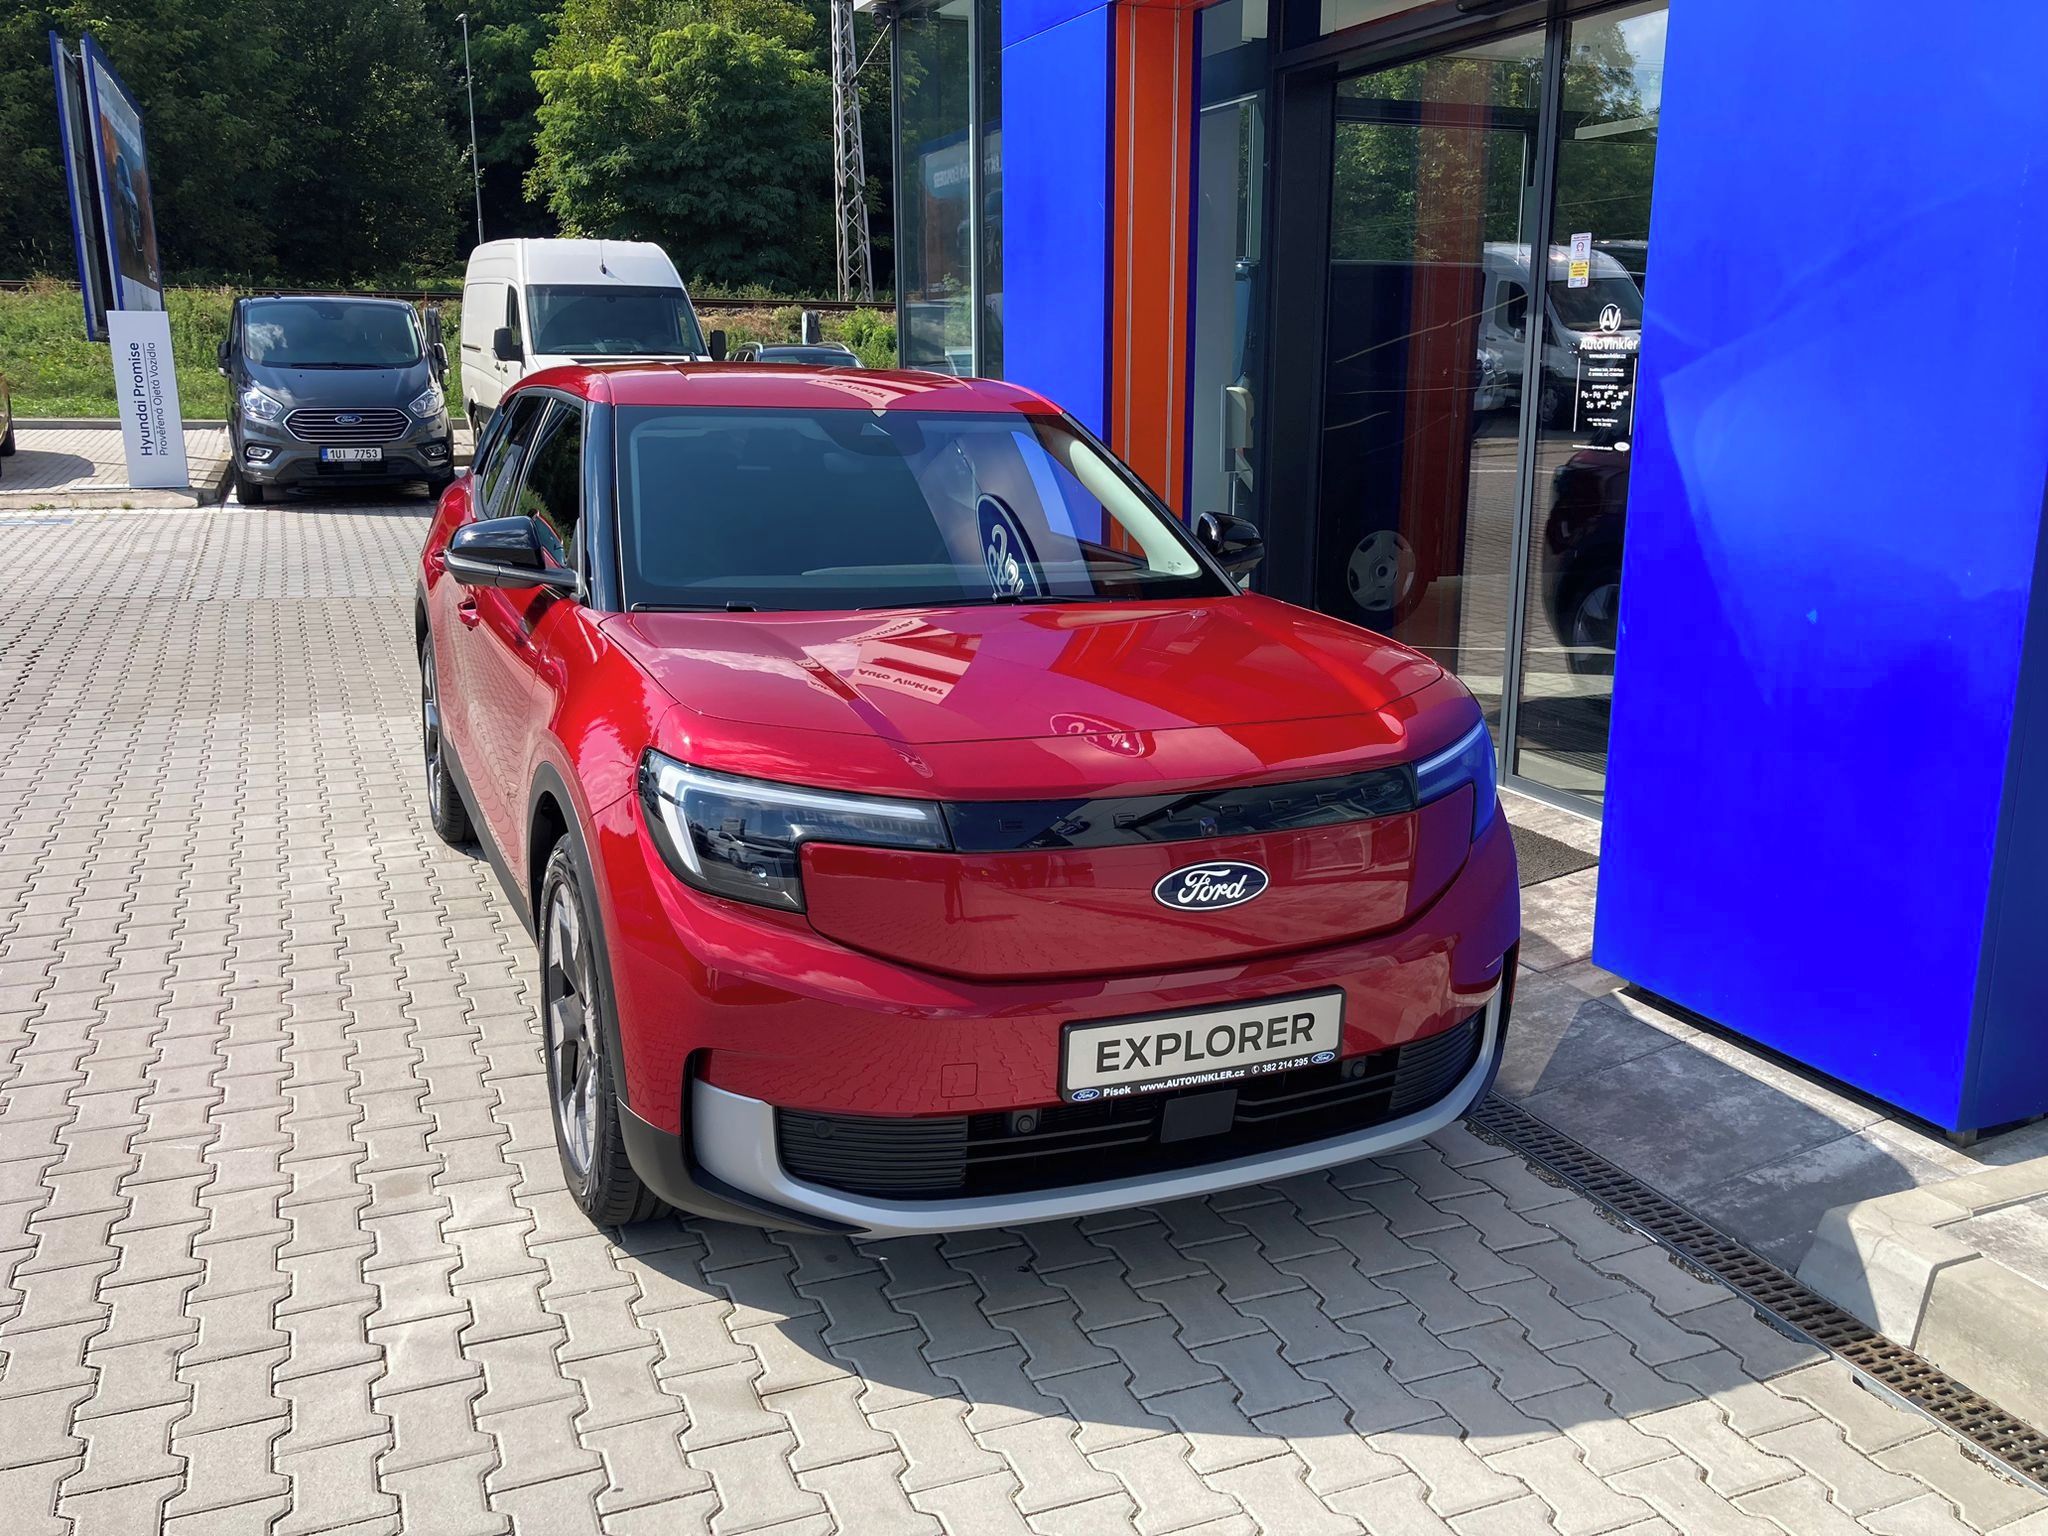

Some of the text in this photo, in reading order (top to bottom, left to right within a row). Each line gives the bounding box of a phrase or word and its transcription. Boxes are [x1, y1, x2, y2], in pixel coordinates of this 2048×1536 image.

[128, 342, 154, 456] Hyundai Promise
[147, 342, 169, 456] Prověřená Ojetá Vozidla
[354, 449, 377, 459] 7753
[1177, 869, 1248, 903] Ford
[1096, 1012, 1316, 1073] EXPLORER
[1262, 1057, 1309, 1073] 382 214 295
[1103, 1069, 1245, 1097] Písek www.AUTOVINKLER.cz
